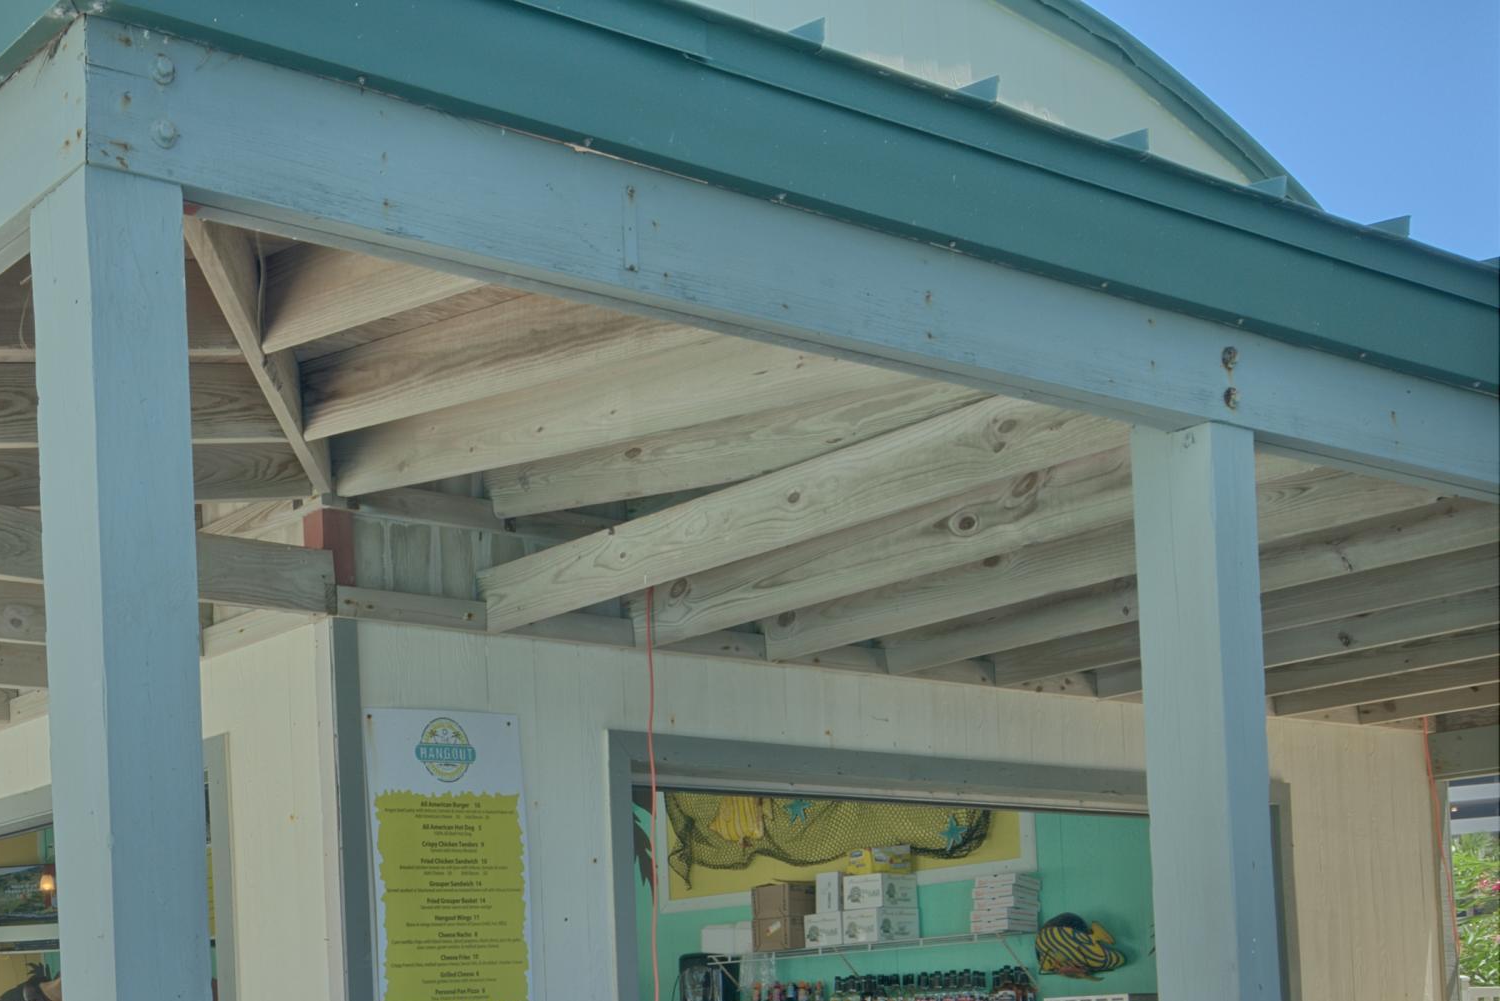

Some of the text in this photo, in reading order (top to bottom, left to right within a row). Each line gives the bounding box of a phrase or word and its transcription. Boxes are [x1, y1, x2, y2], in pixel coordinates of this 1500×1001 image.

[420, 746, 473, 762] HANGOUT
[429, 824, 454, 832] American
[454, 824, 464, 832] Hot
[464, 824, 475, 832] Dog
